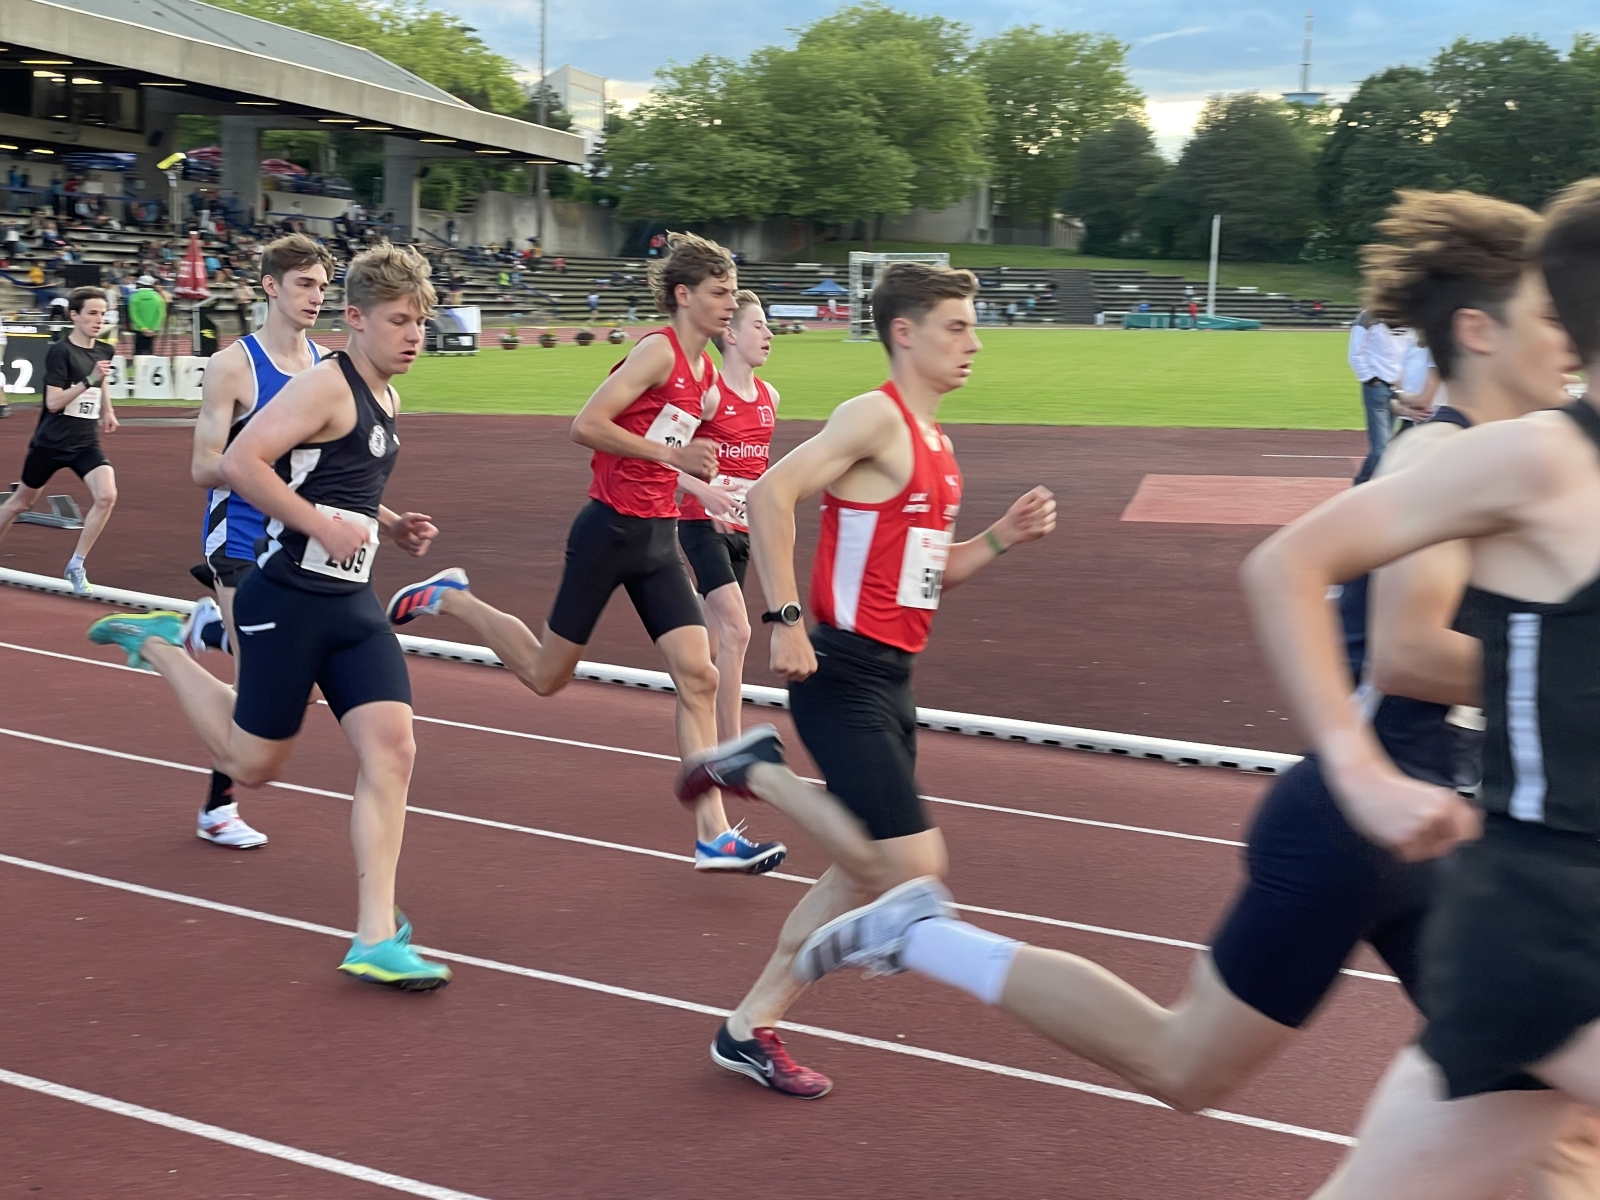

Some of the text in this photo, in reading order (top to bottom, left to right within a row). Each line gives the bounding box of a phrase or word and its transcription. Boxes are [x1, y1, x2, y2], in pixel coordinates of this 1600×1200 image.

[109, 365, 119, 386] 3
[151, 366, 165, 386] 6
[79, 401, 95, 415] 157
